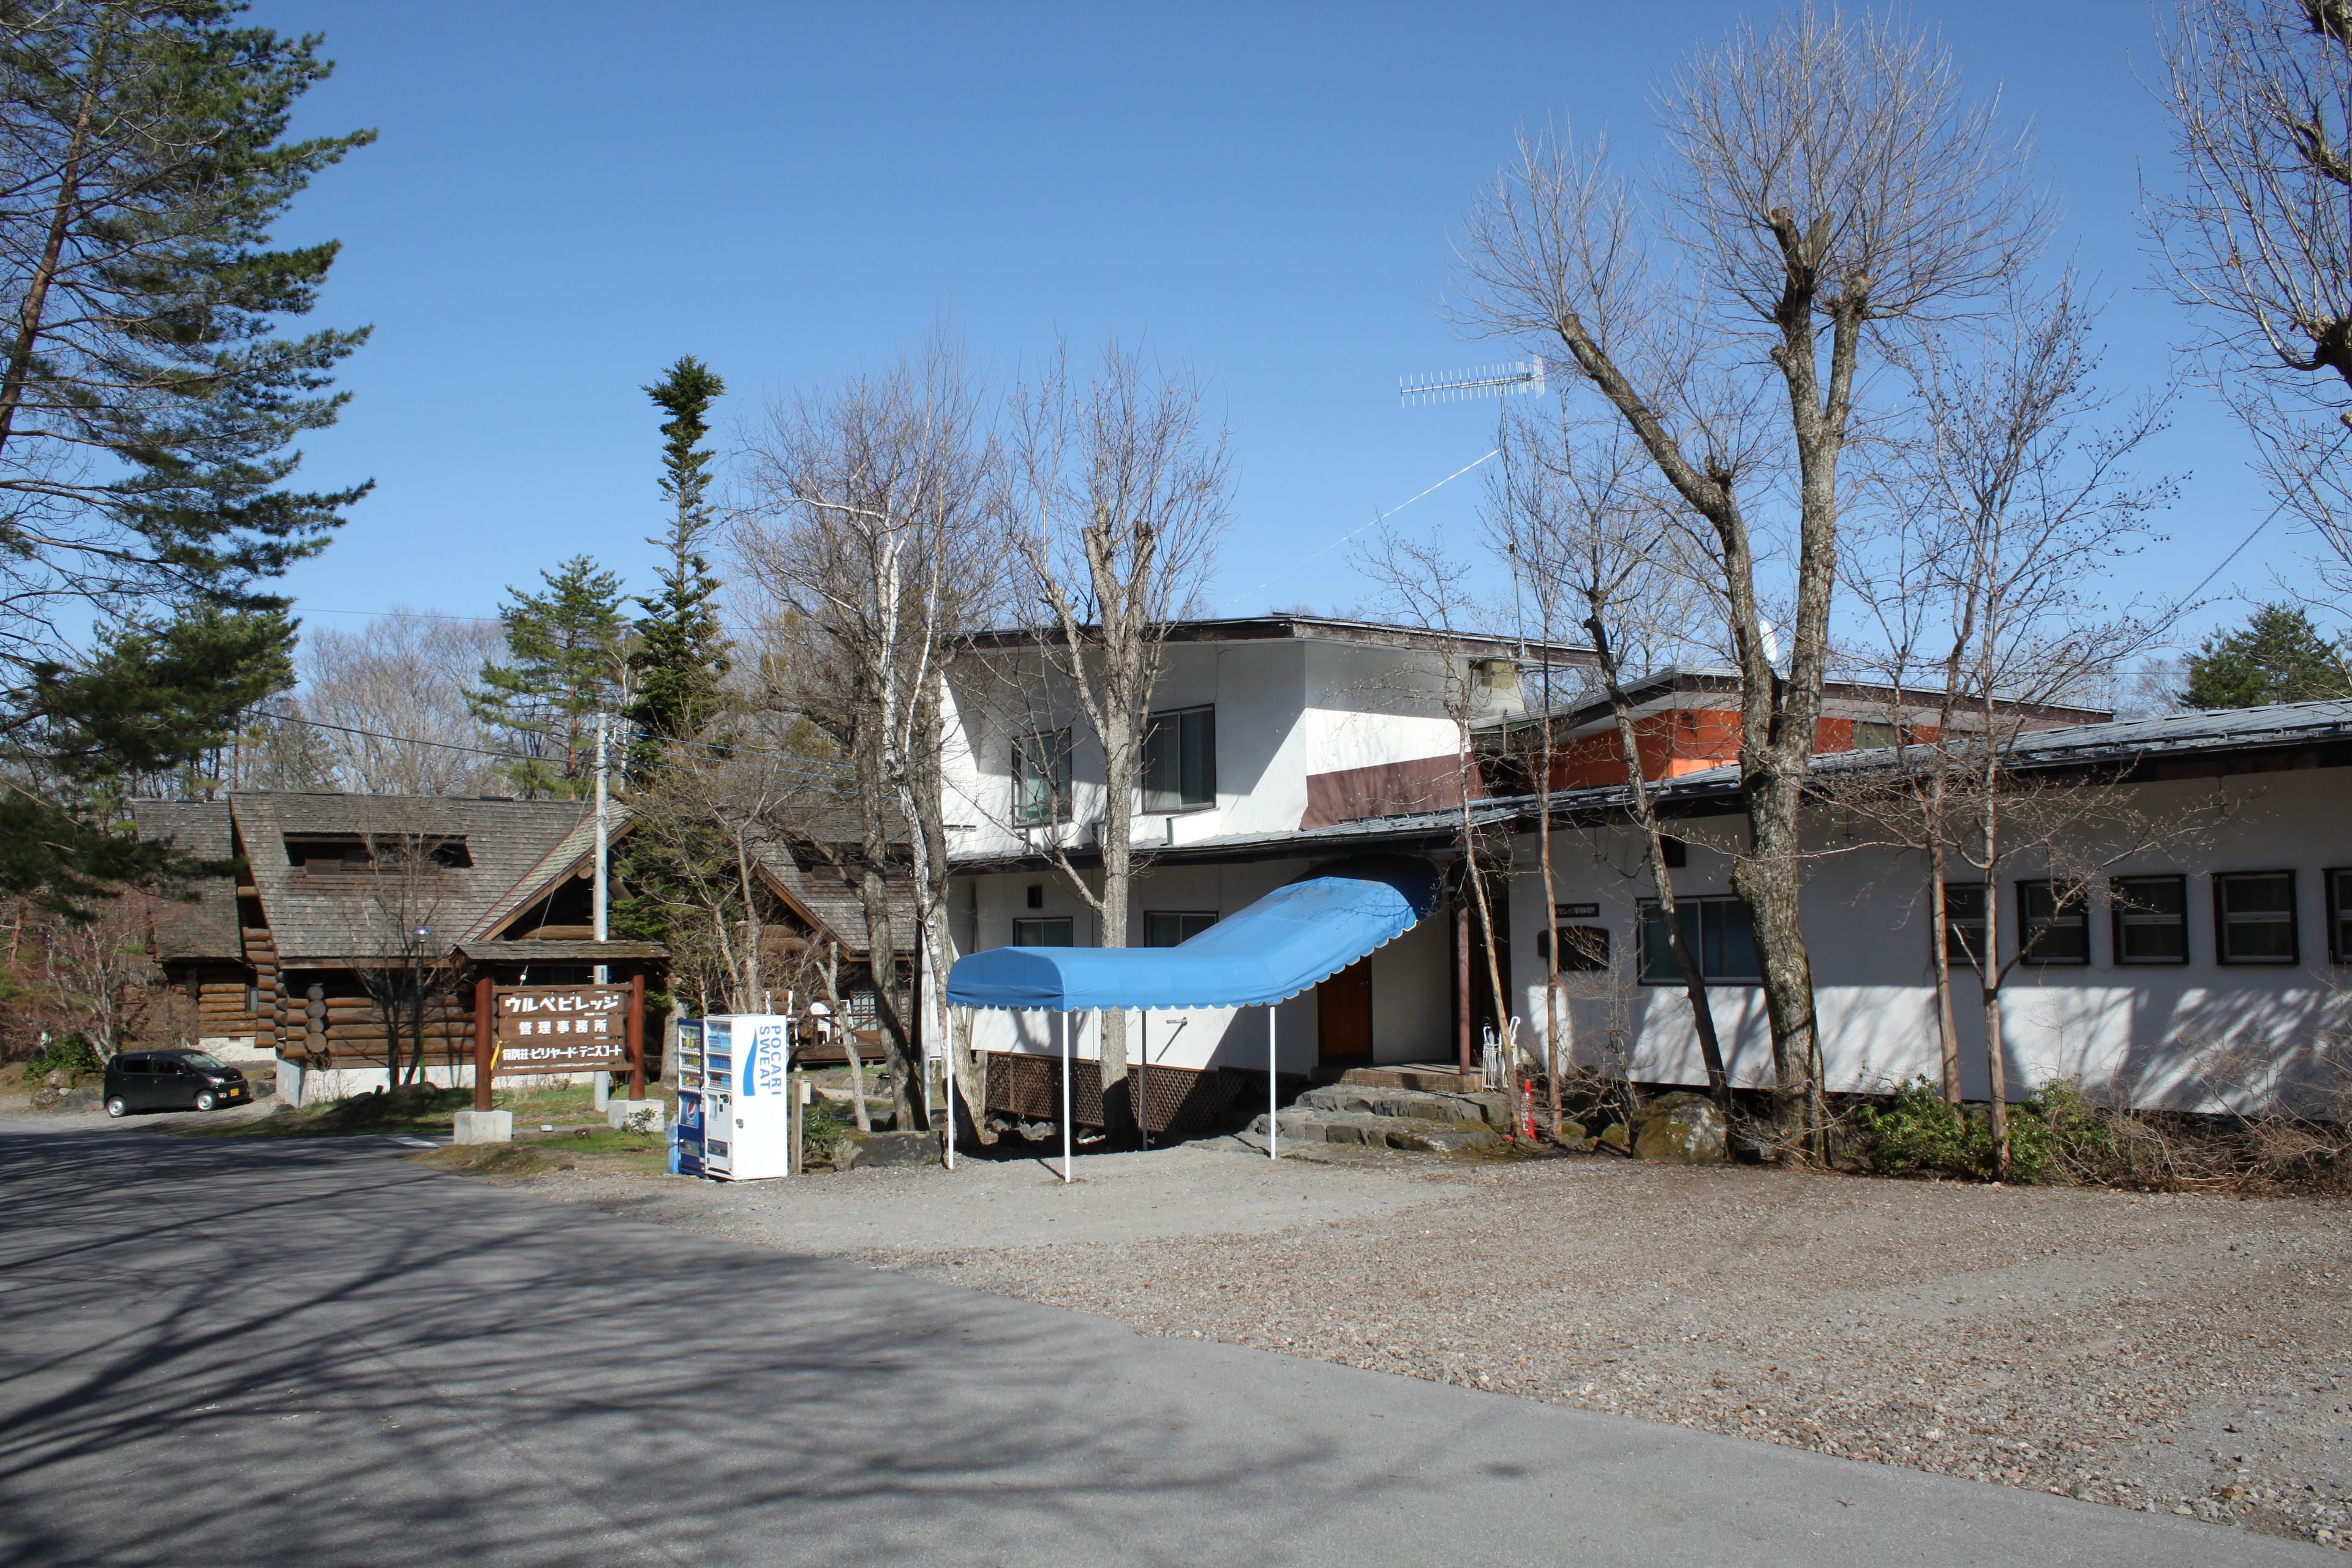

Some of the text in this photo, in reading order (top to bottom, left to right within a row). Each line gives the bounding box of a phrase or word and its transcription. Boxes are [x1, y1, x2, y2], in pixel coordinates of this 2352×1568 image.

[505, 995, 619, 1012] ウルベビレッジ
[519, 1019, 607, 1036] 管理事務所
[760, 1026, 770, 1088] SWEAT
[772, 1025, 781, 1095] POCARI
